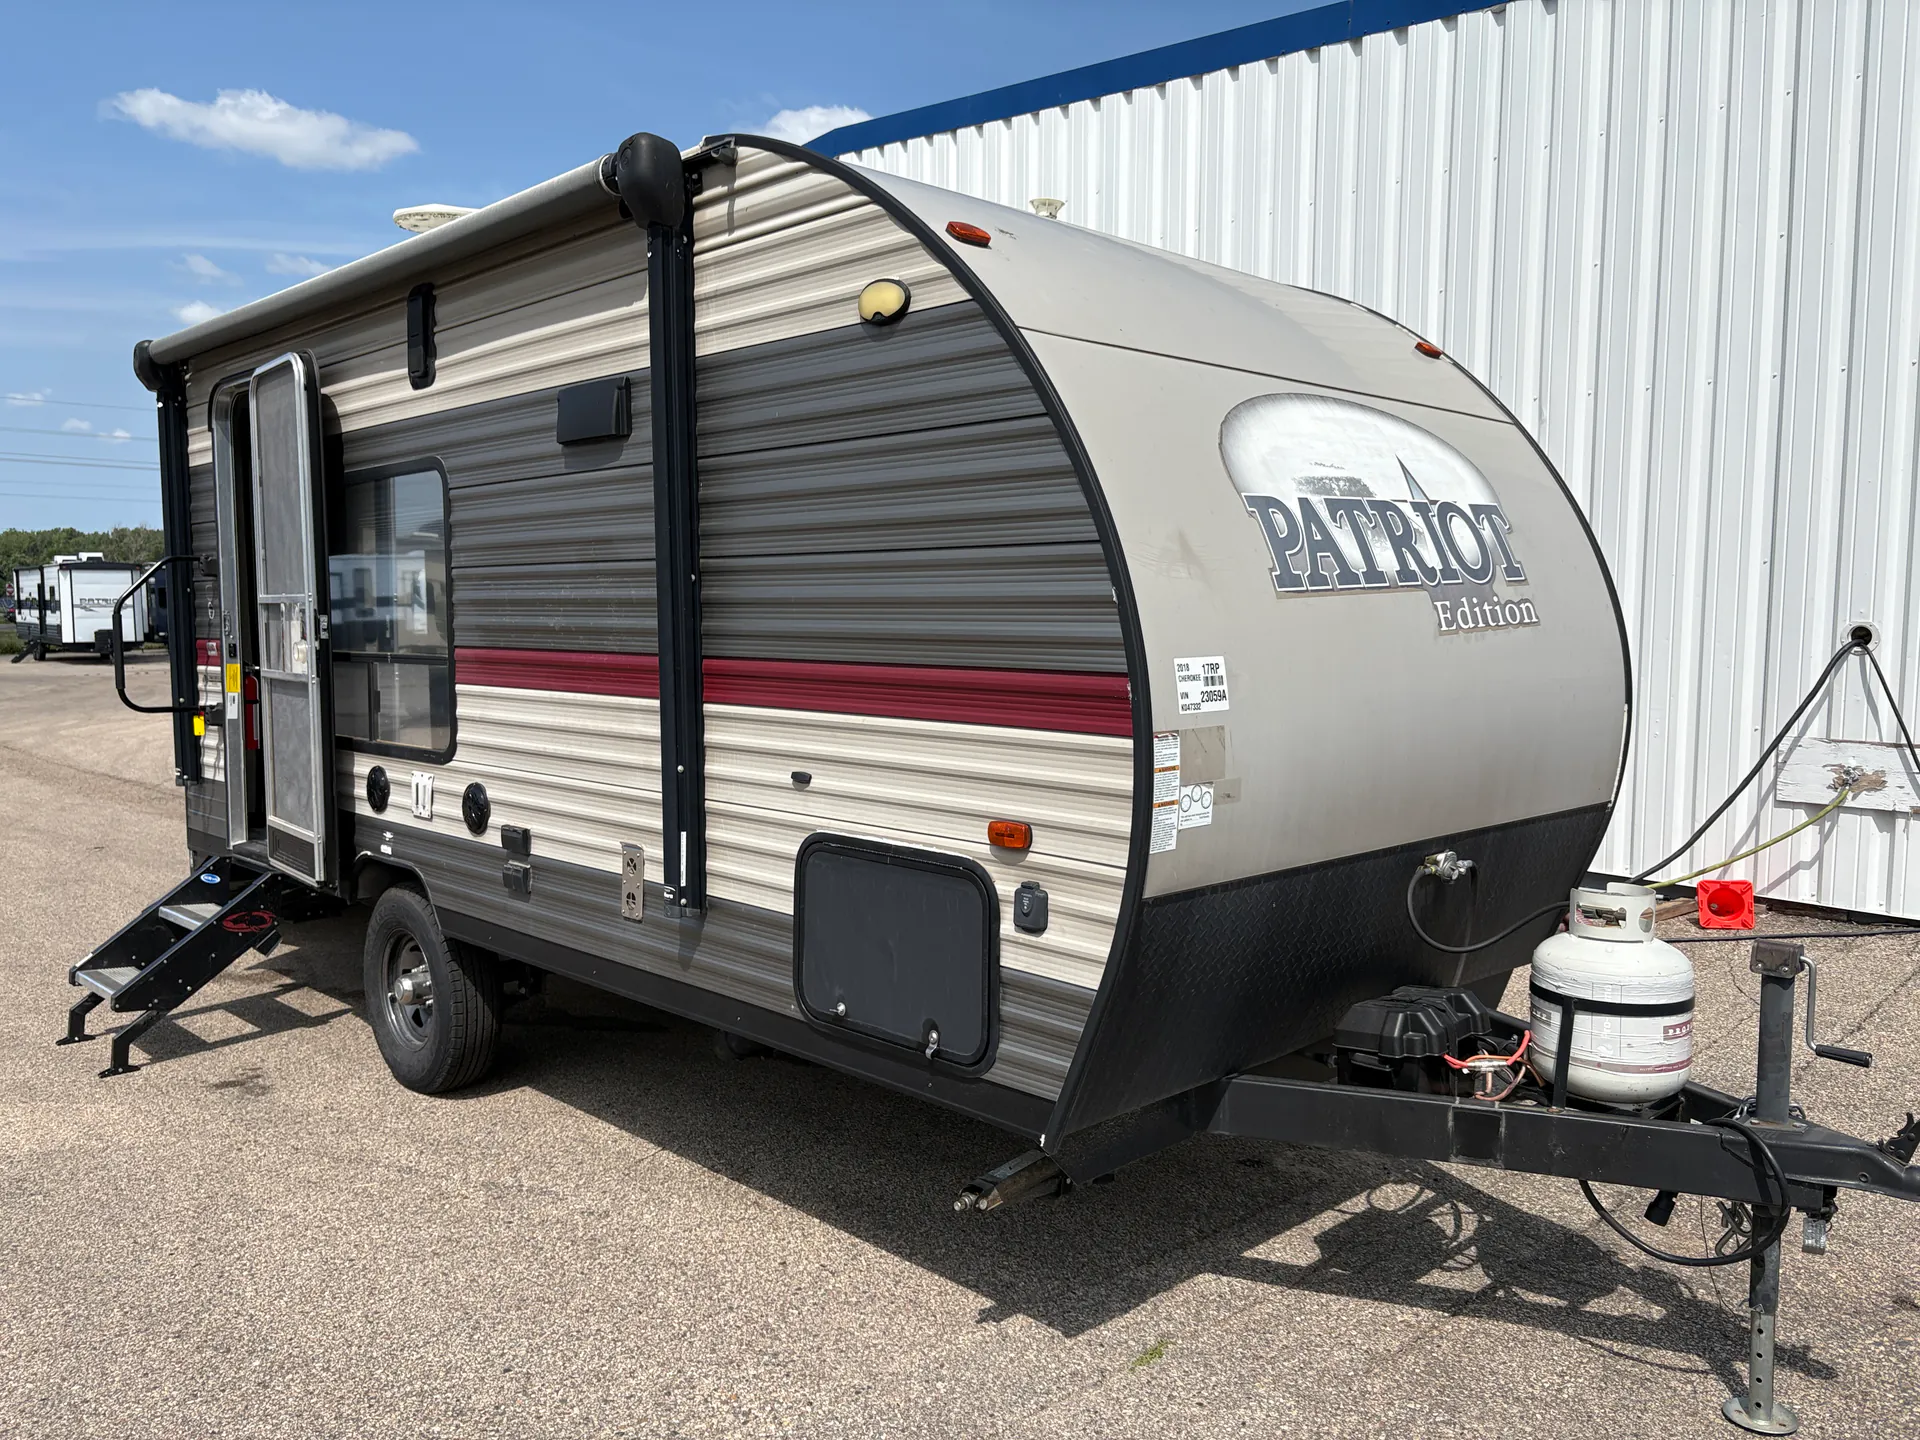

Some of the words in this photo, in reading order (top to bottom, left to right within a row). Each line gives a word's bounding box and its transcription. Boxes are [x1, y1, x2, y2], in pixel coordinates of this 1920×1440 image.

[1241, 492, 1526, 592] PATRIOT
[79, 597, 118, 606] PATRIO
[1433, 597, 1539, 631] Edition
[1177, 663, 1190, 672] 2018
[1201, 663, 1220, 674] 17RP
[1178, 674, 1201, 682] CHEROKEE
[1200, 689, 1227, 702] 23059A
